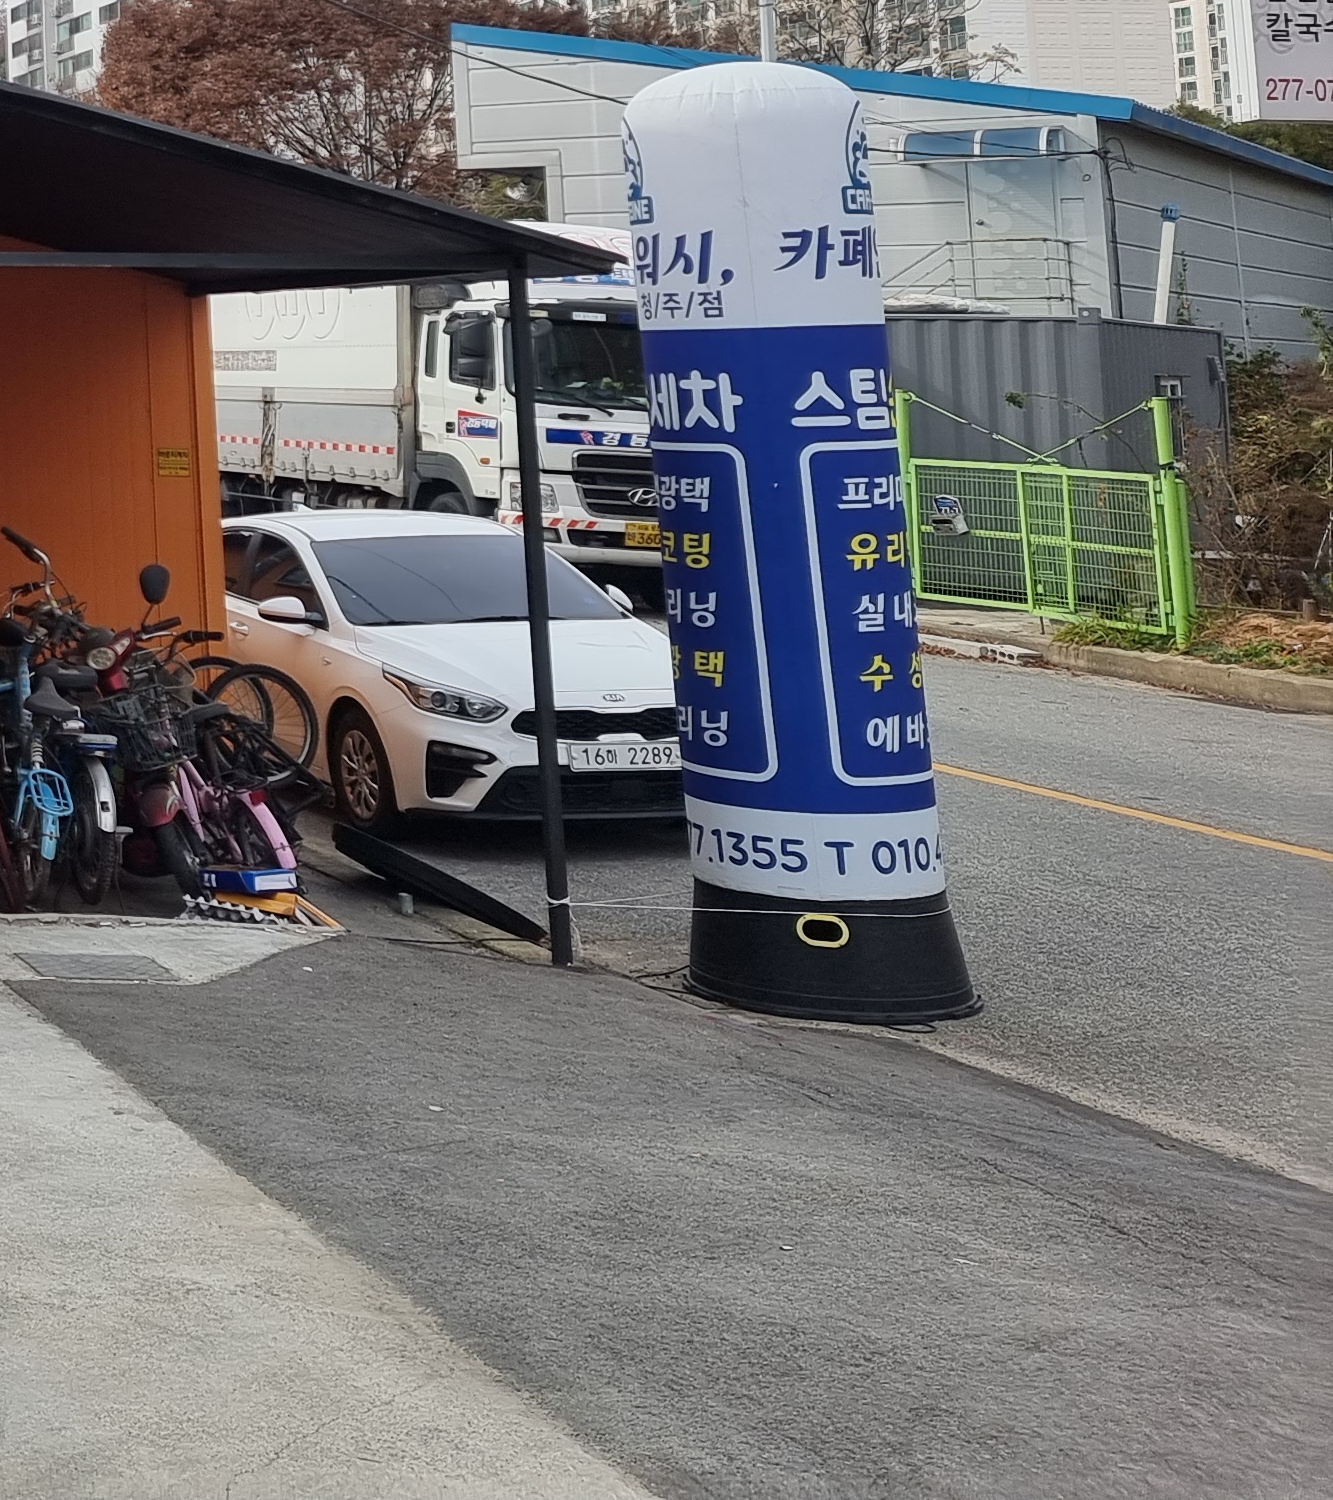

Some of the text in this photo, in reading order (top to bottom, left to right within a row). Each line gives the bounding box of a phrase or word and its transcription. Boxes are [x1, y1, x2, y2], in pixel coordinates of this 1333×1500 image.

[630, 199, 651, 223] NE
[773, 225, 882, 280] 카페
[791, 368, 896, 431] 스팀
[653, 474, 711, 513] 광택
[851, 590, 918, 633] 실내
[865, 711, 932, 753] 에바
[627, 746, 673, 766] 2289
[688, 822, 809, 873] 7.1355
[823, 841, 855, 876] T
